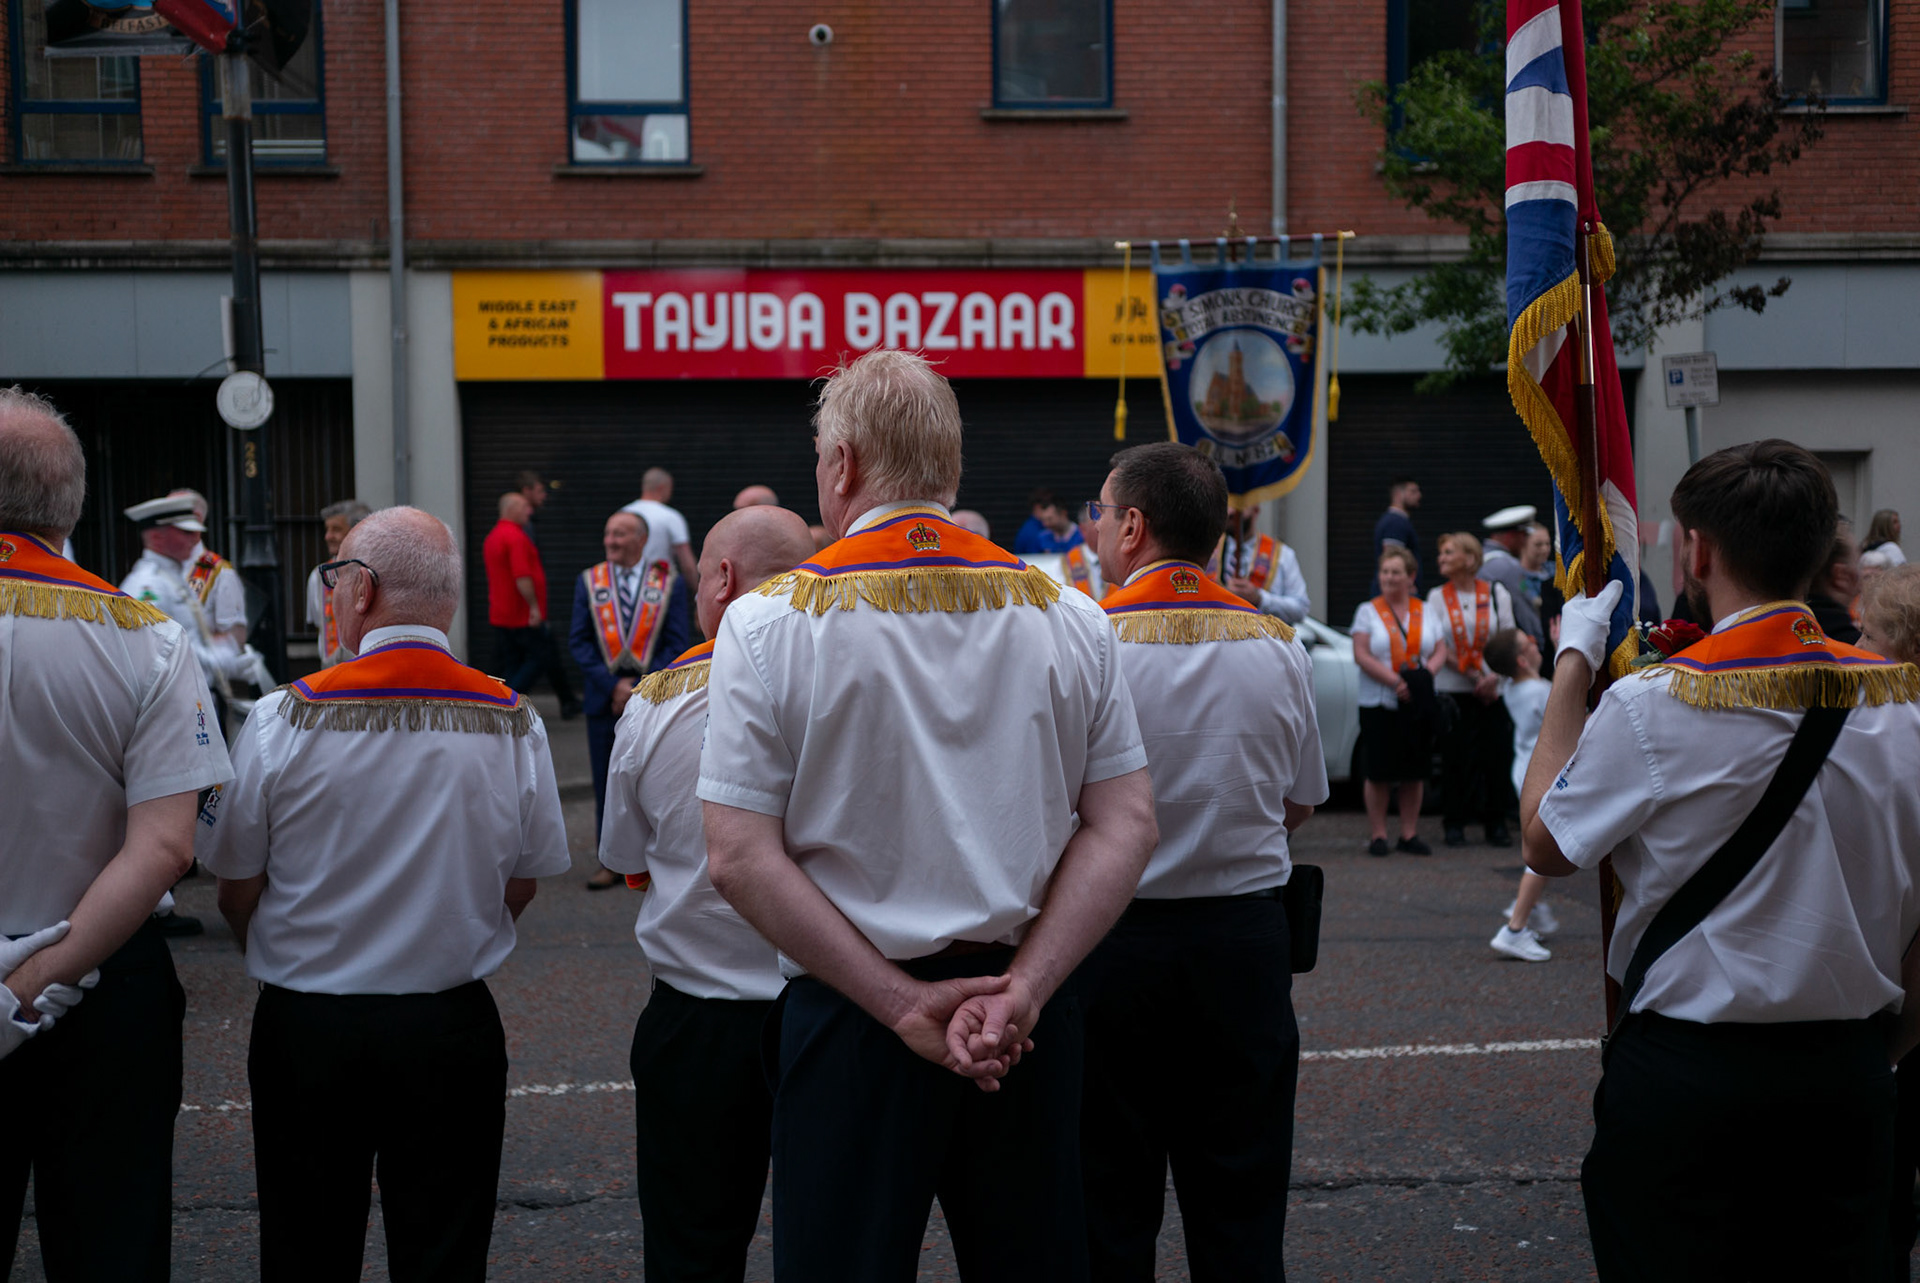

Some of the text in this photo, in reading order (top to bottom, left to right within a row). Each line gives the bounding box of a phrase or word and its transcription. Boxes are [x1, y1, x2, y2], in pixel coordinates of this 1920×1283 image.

[100, 15, 163, 32] BELFAST
[479, 300, 577, 313] MIDDLE EAST
[489, 318, 569, 330] & AFRICAN
[612, 292, 825, 351] TAYIBA
[844, 292, 1075, 350] BAZAAR
[488, 335, 569, 347] PRODUCTS
